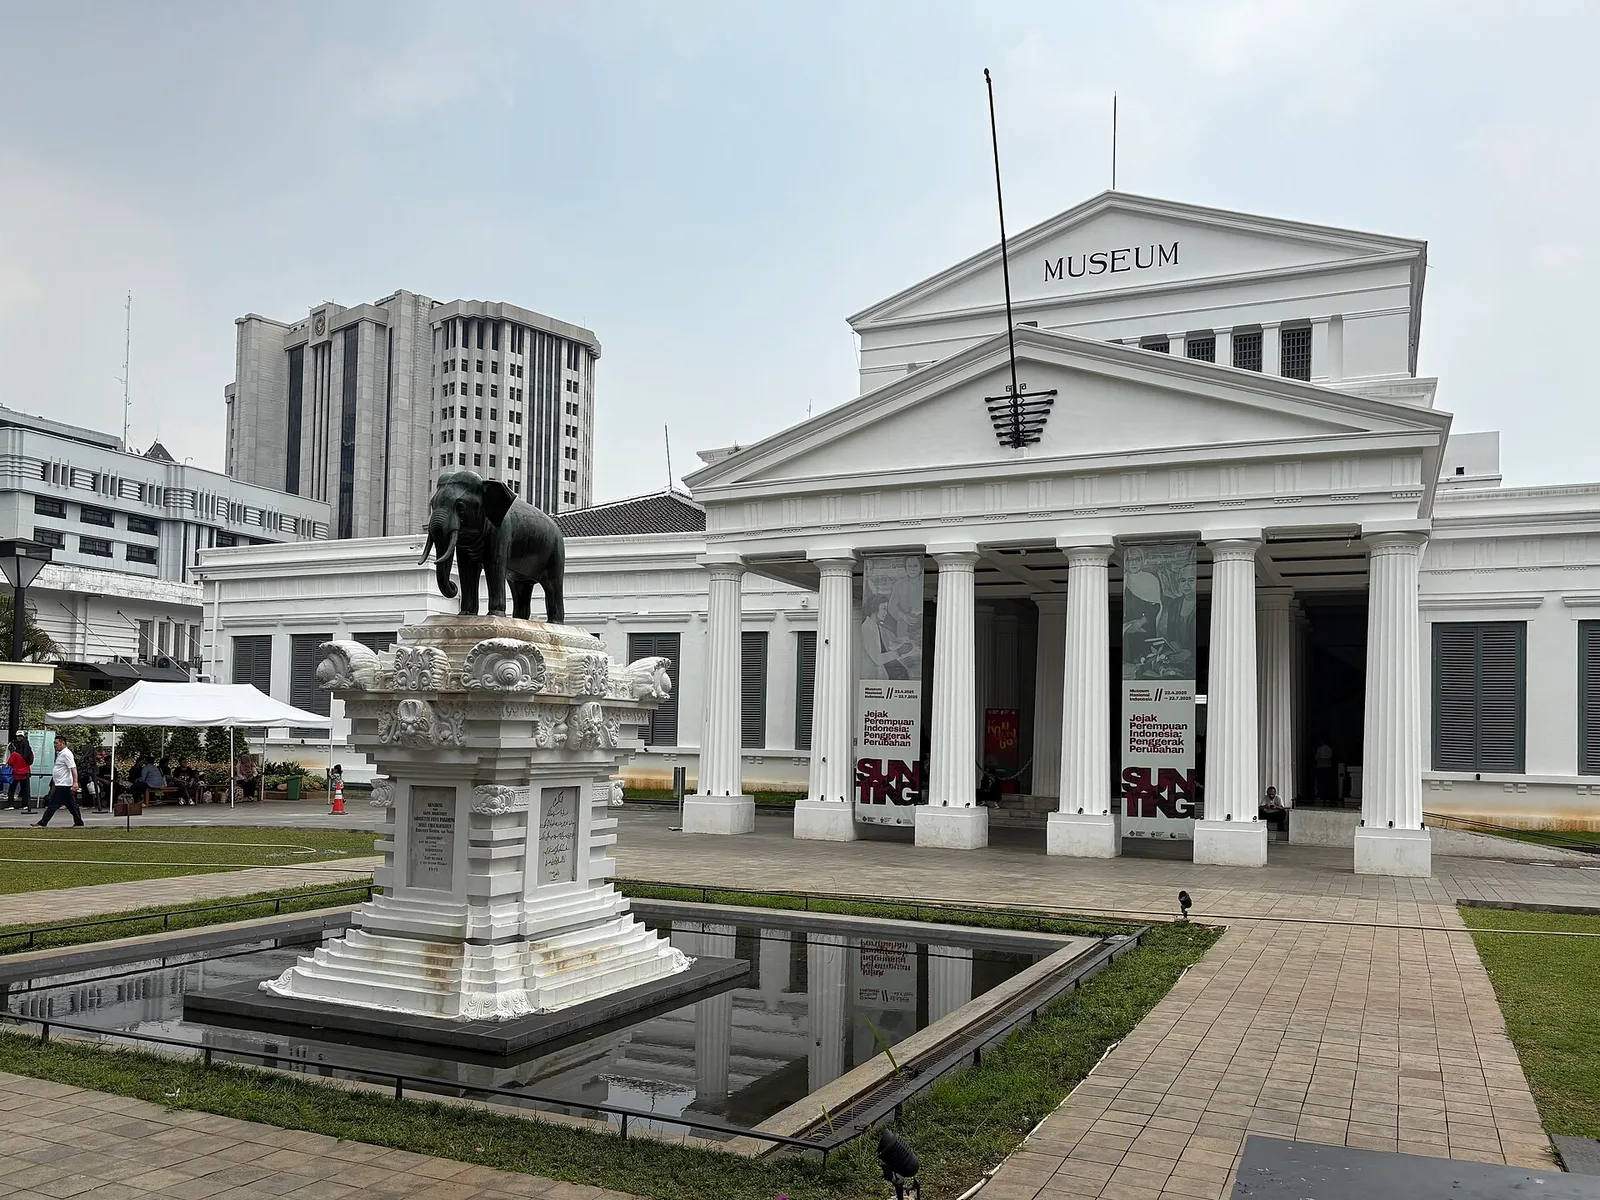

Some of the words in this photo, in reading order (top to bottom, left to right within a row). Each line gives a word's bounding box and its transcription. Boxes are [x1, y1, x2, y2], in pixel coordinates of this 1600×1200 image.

[1044, 241, 1179, 282] MUSEUM
[864, 710, 888, 719] Jejak
[1129, 714, 1158, 723] Jejak
[864, 717, 914, 726] Perempuan
[1129, 722, 1187, 731] Perempuan
[863, 732, 911, 741] Penggerak
[1129, 730, 1182, 738] Indonesia:
[863, 739, 911, 747] Perubahan
[1129, 738, 1184, 747] Penggerak
[1129, 745, 1184, 753] Perubahan
